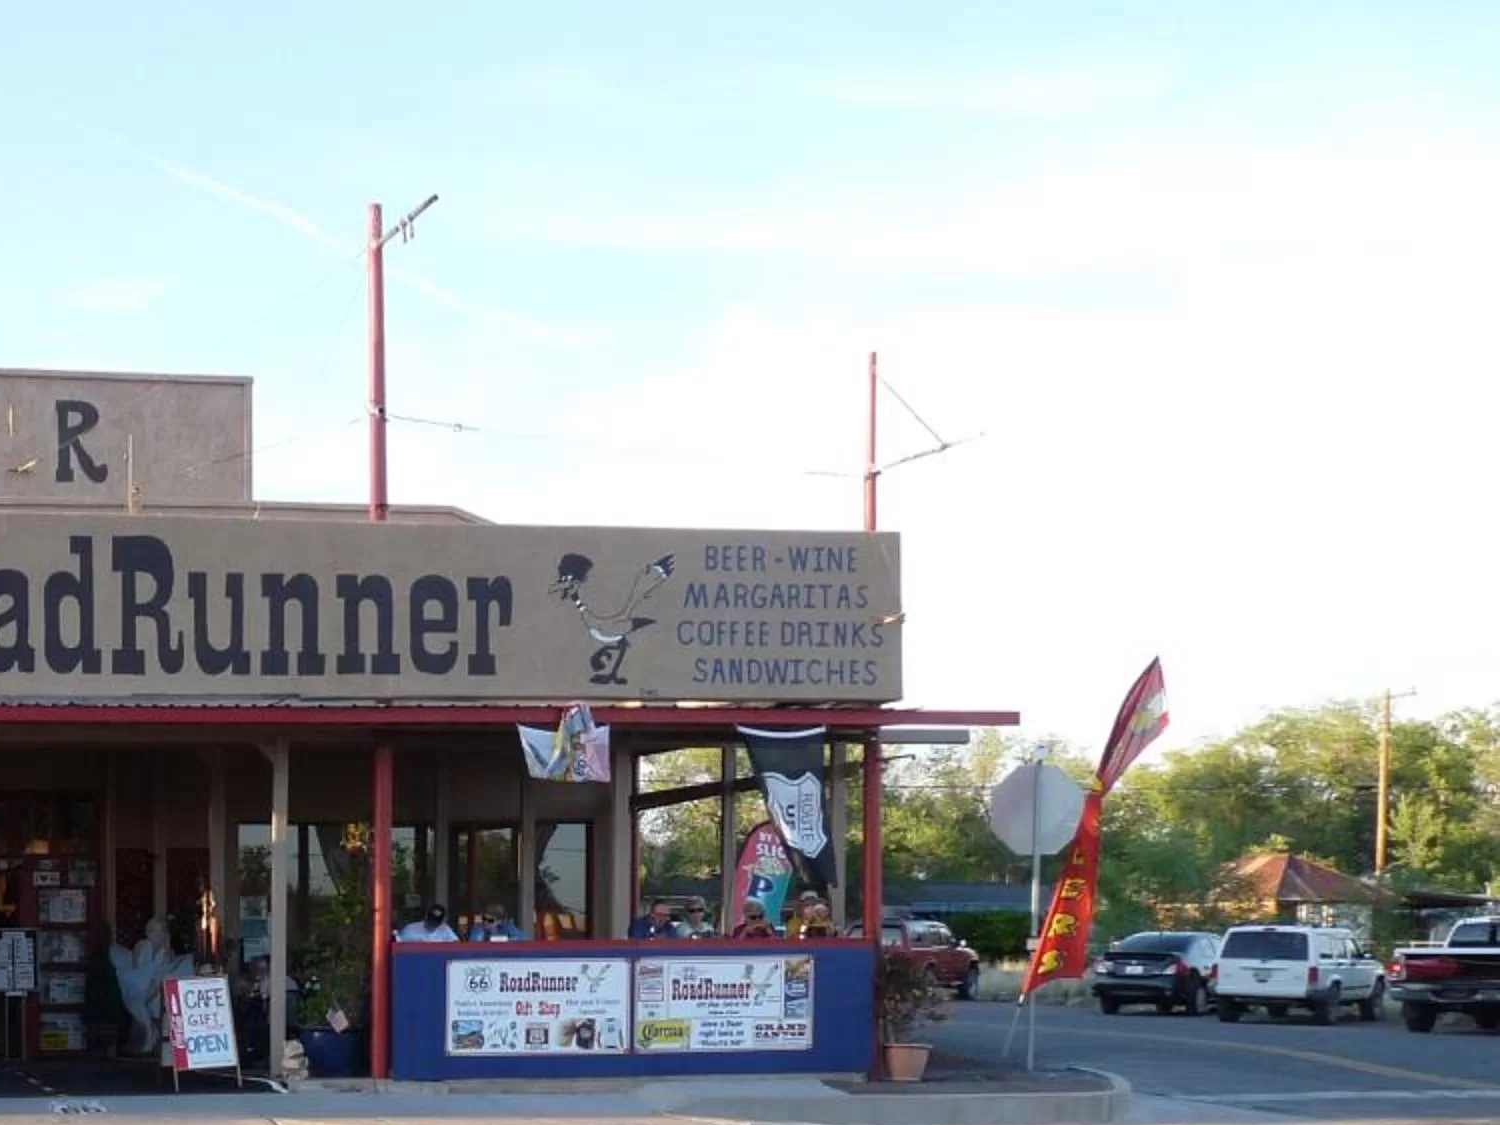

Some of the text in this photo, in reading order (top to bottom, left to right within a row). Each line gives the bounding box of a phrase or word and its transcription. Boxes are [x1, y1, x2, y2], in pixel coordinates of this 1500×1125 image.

[55, 399, 108, 483] R
[683, 583, 869, 609] MARGARITAS
[676, 620, 885, 647] COFFEE DRINKS
[692, 657, 878, 685] SANDWICHES
[469, 975, 489, 989] 66
[499, 970, 579, 993] RoadRunner
[672, 977, 751, 1001] RoadRunner
[186, 1032, 228, 1054] OPEN
